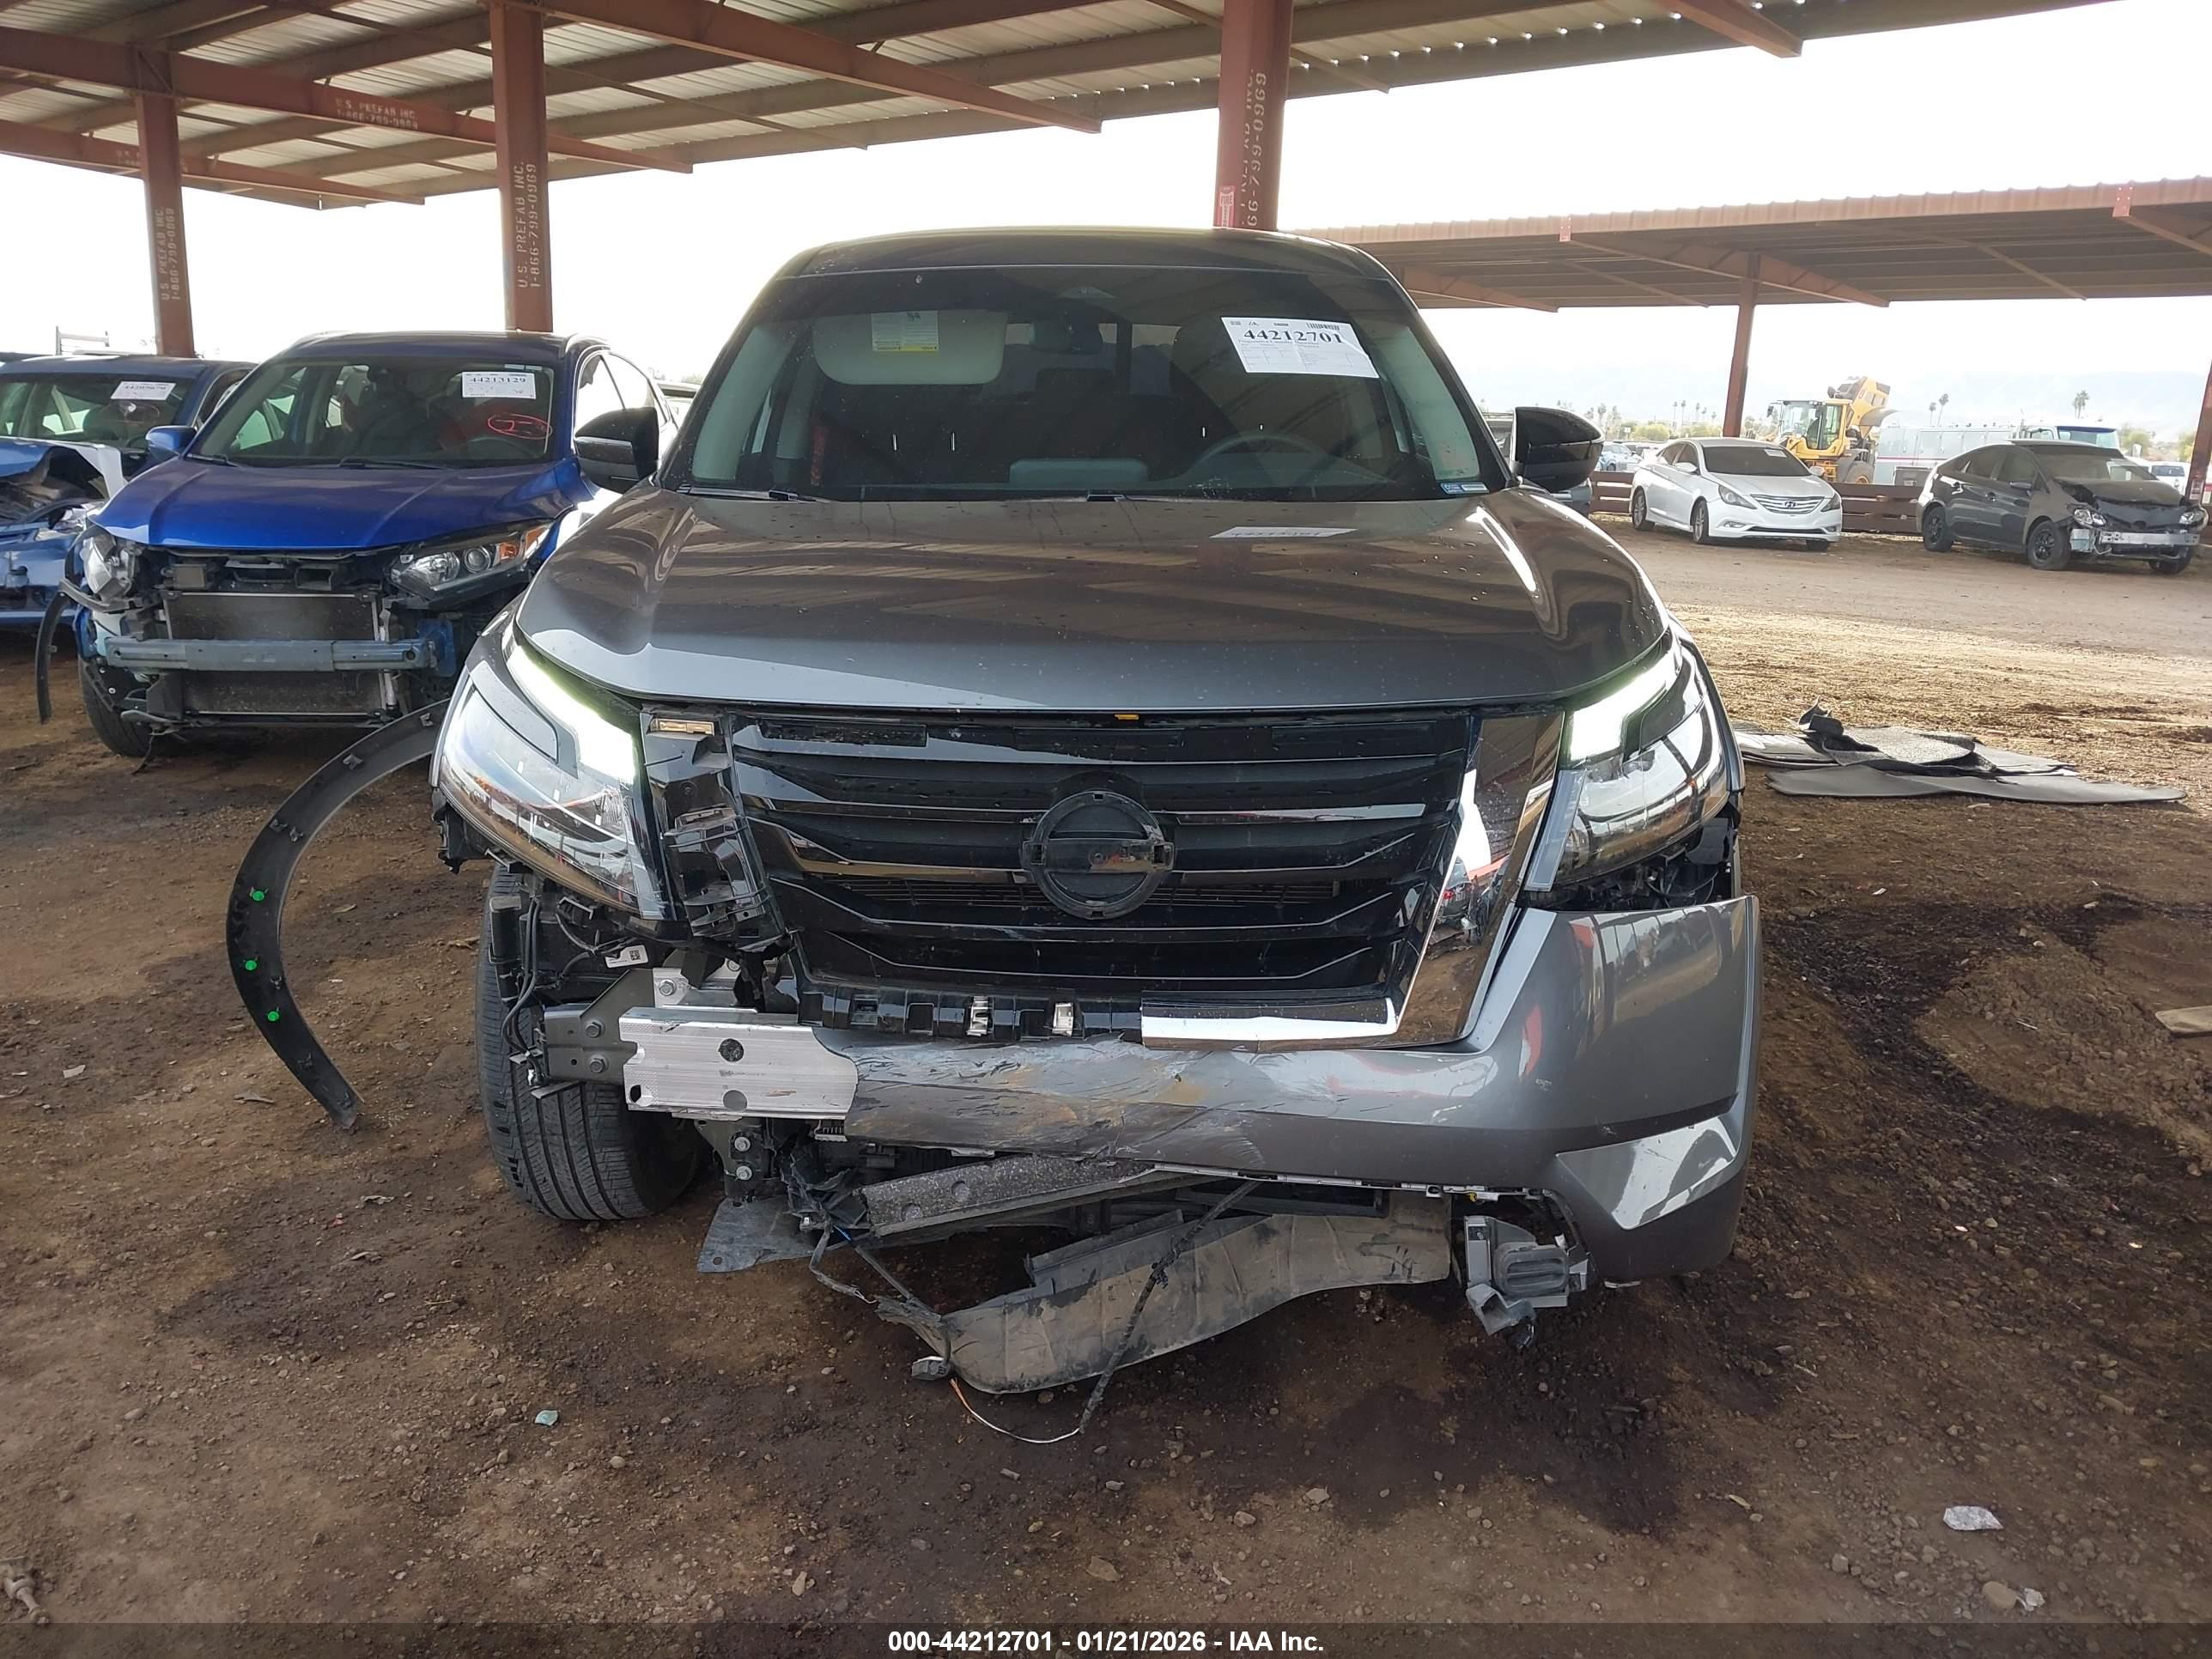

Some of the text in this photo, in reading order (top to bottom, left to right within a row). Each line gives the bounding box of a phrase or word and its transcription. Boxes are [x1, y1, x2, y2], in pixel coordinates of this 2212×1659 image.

[514, 161, 528, 289] U.S. PREFAB INC.
[526, 164, 541, 288] 1-866-799-0969
[1243, 329, 1345, 343] 44212701
